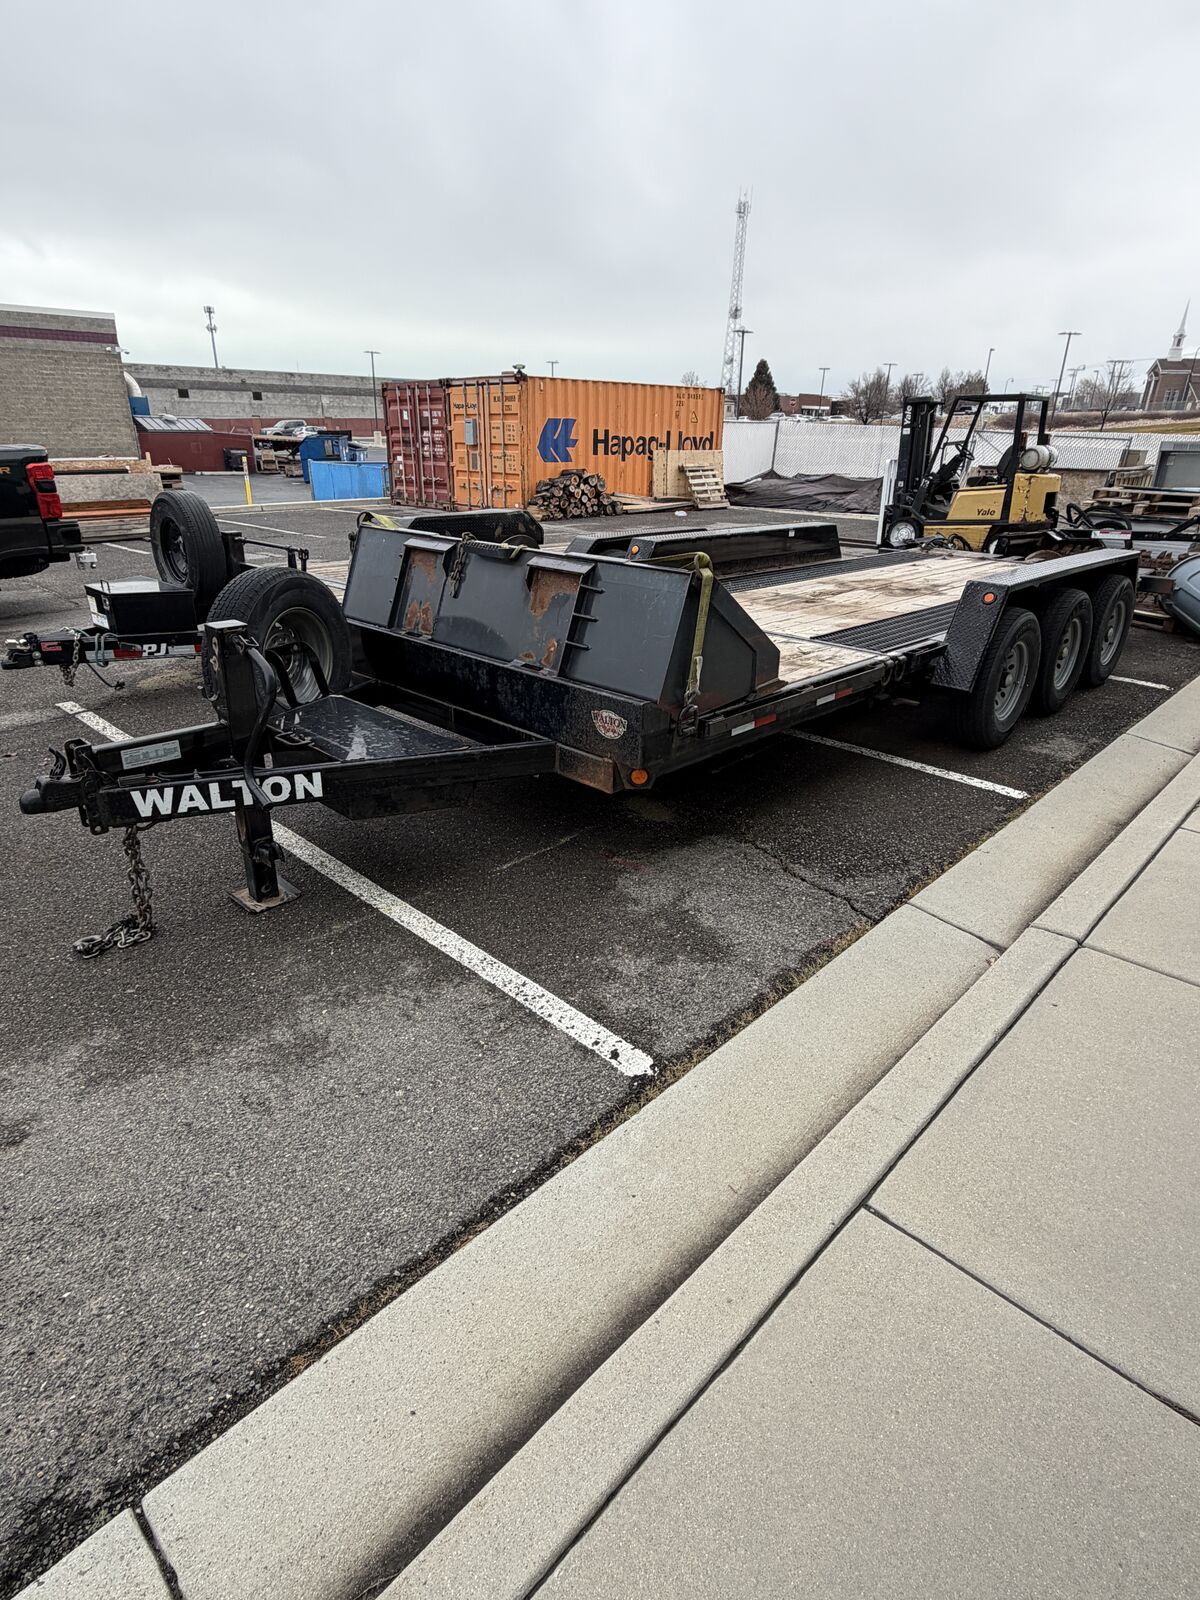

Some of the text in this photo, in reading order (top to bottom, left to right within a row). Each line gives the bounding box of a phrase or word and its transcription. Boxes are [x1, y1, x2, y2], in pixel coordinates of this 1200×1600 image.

[903, 405, 913, 425] Yale
[977, 508, 996, 517] Yale
[142, 643, 168, 657] PJ
[130, 771, 324, 818] WALTON
